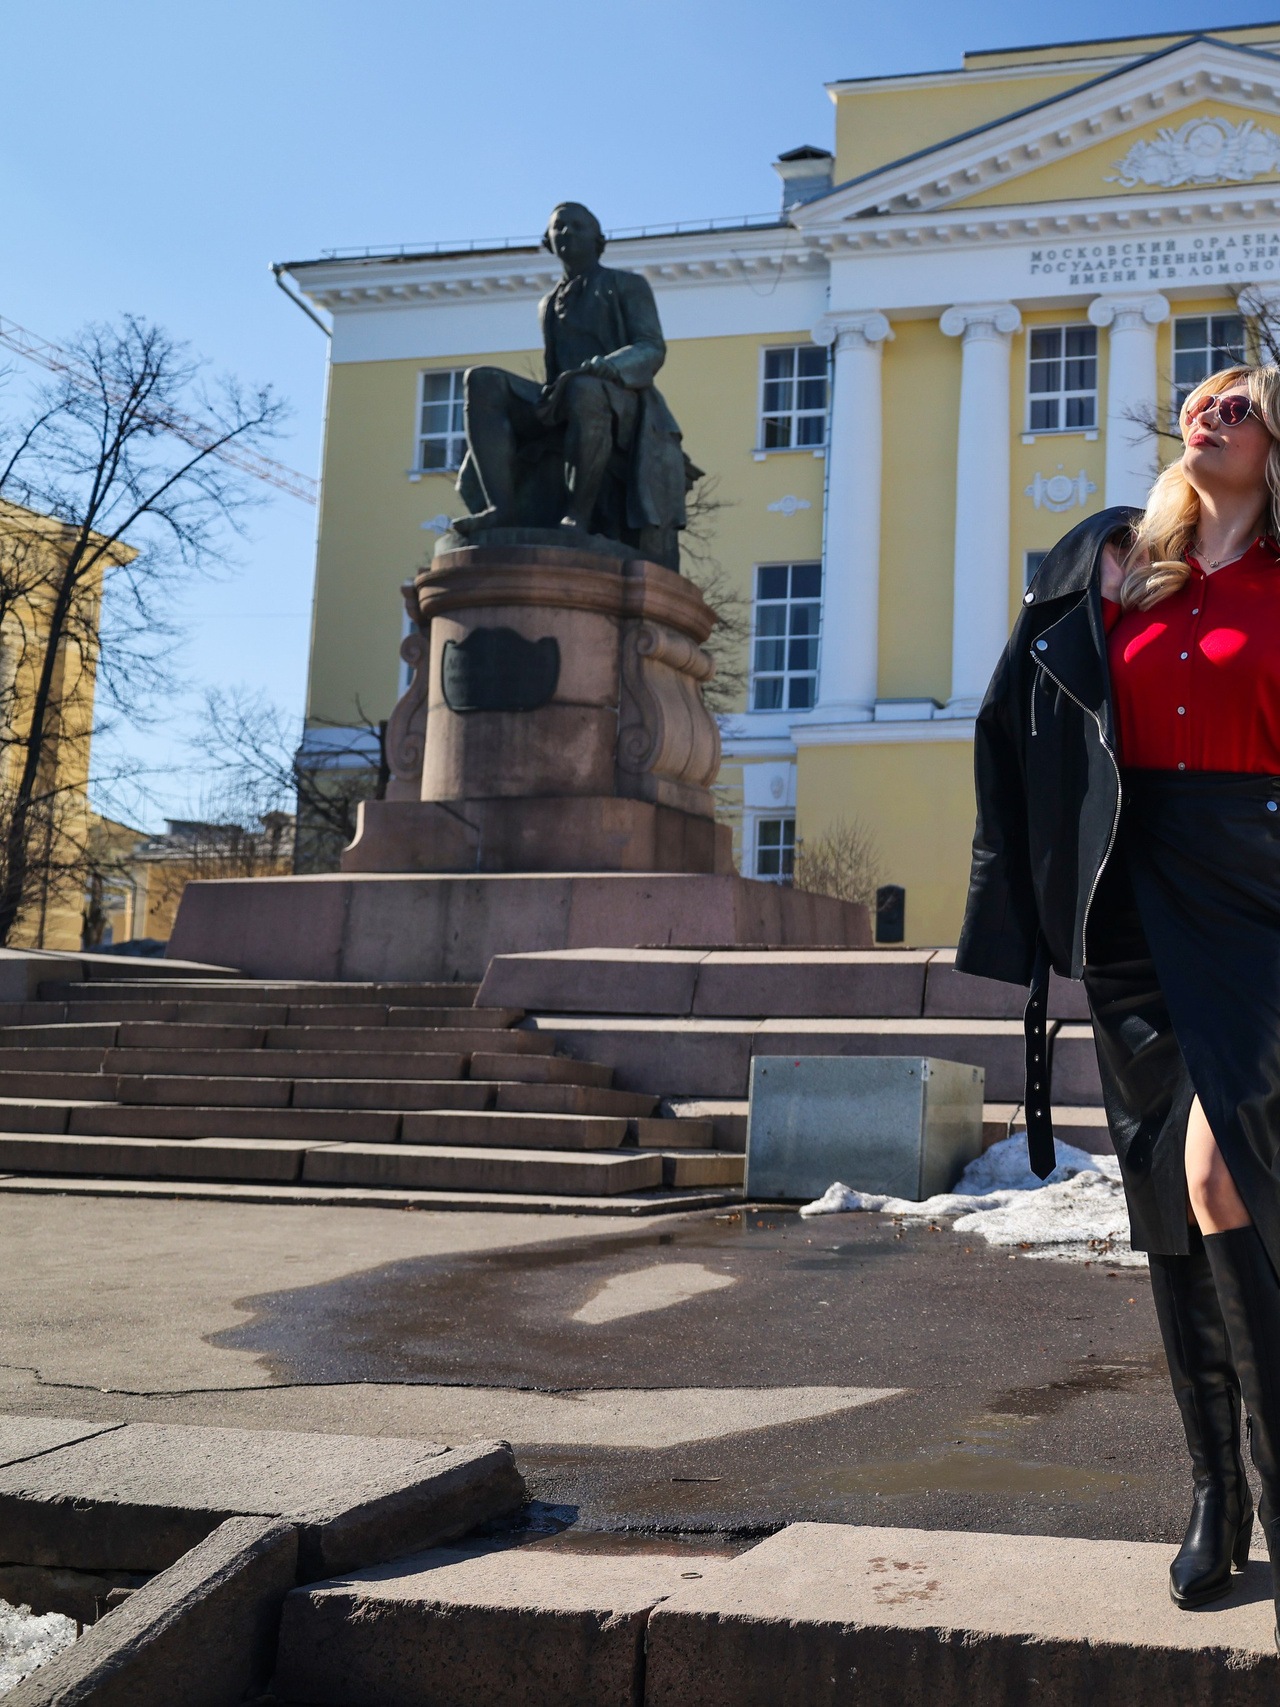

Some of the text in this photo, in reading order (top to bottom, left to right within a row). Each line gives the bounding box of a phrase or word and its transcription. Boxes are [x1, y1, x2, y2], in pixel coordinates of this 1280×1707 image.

[1030, 239, 1177, 262] МОСКОВСКИЙ
[1193, 232, 1280, 249] ОРДЕНА
[1030, 248, 1226, 275] ГОСУДАРСТВЕННЫЙ
[1069, 270, 1137, 285] ИМЕНИ
